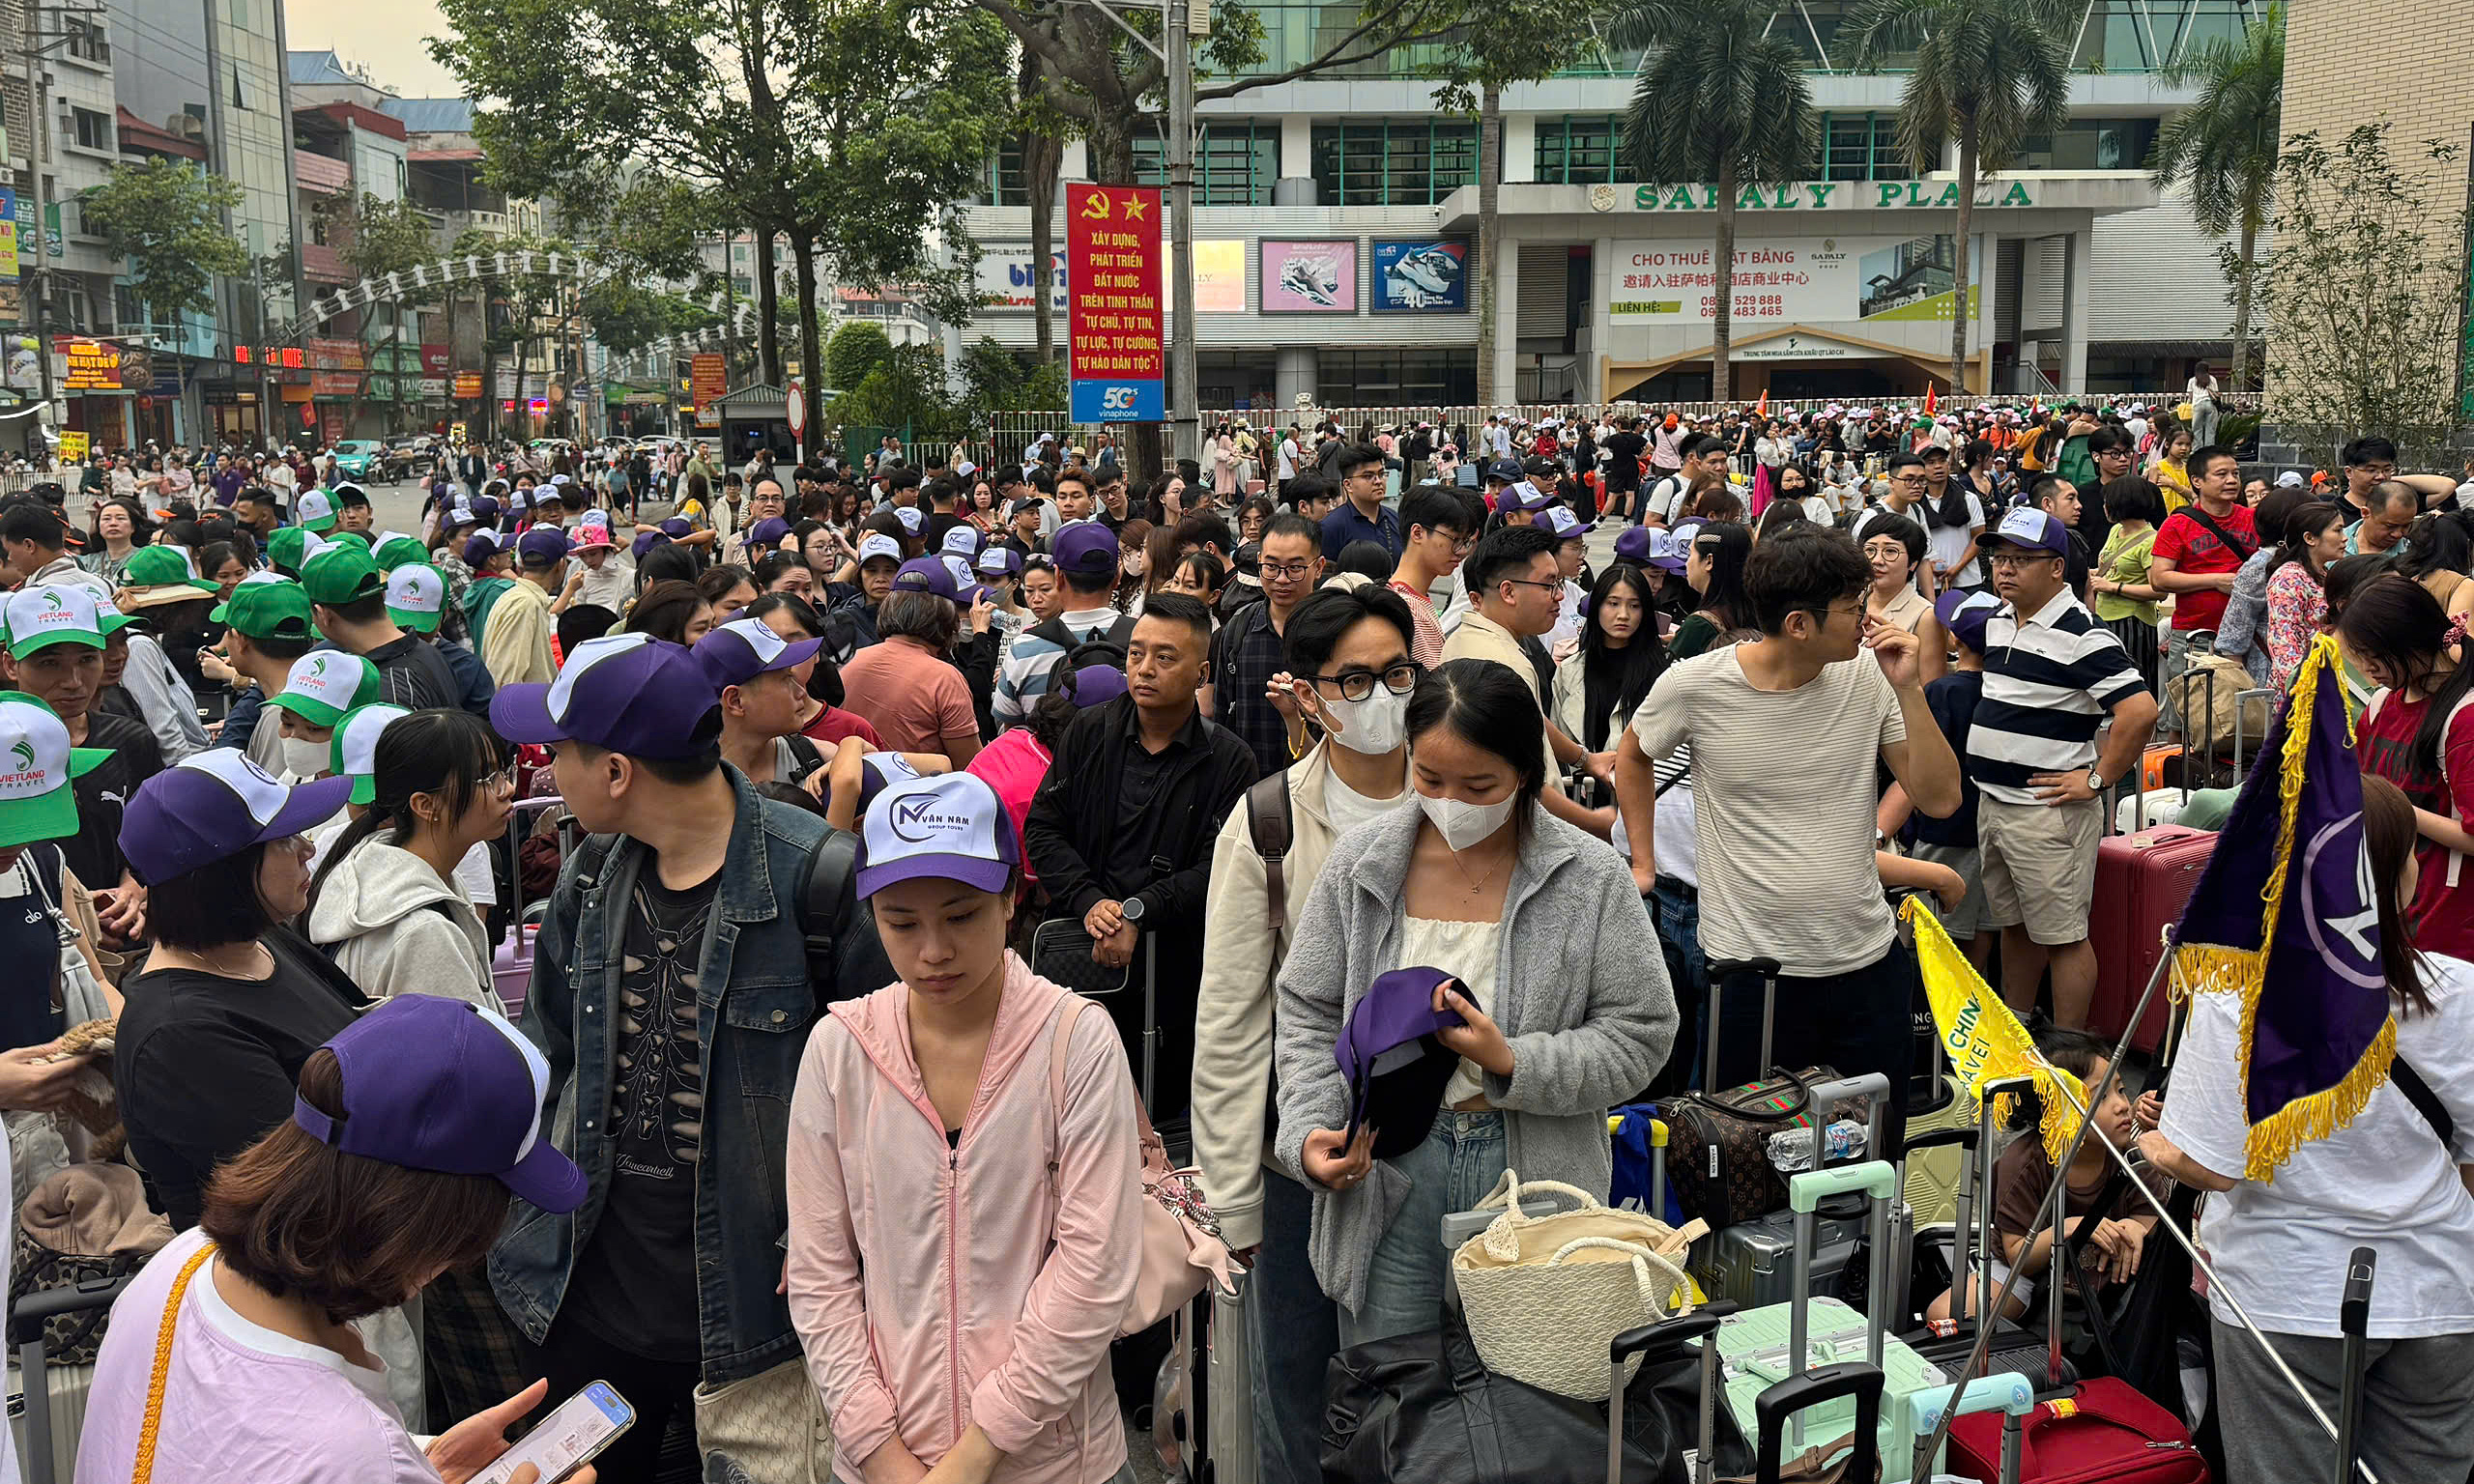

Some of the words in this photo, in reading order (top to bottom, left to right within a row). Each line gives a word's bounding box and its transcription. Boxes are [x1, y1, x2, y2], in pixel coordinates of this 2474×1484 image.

[1876, 182, 2031, 207] PLAZA
[1091, 230, 1109, 245] XÂY
[1112, 233, 1140, 249] DỰNG,
[1090, 251, 1113, 266] PHÁT
[1116, 250, 1142, 268] TRIỂN
[1632, 253, 1665, 266] CHO
[1669, 249, 1710, 266] THUÊ
[1094, 270, 1112, 287] ĐẤT
[1114, 272, 1139, 288] NƯỚC
[1080, 292, 1104, 307] TRÊN
[1107, 295, 1128, 308] TINH
[1618, 301, 1641, 312] LIÊN
[1643, 300, 1660, 314] HỆ:
[1735, 296, 1756, 305] 529
[1759, 295, 1782, 305] 888
[1734, 306, 1756, 316] 483
[1759, 305, 1782, 316] 465
[1100, 312, 1121, 329] CHỦ,
[1123, 316, 1136, 331] TỰ
[1137, 317, 1155, 330] TIN,
[1076, 335, 1087, 351] TỰ
[1090, 335, 1109, 351] LỰC,
[1112, 335, 1125, 352] TỰ
[1126, 334, 1160, 351] CƯỜNG,
[1077, 356, 1089, 372] TỰ
[1091, 355, 1109, 369] HÀO
[1112, 355, 1131, 369] DÂN
[1099, 410, 1138, 418] vinaphone
[922, 813, 943, 823] VÂN
[947, 815, 969, 825] NAM
